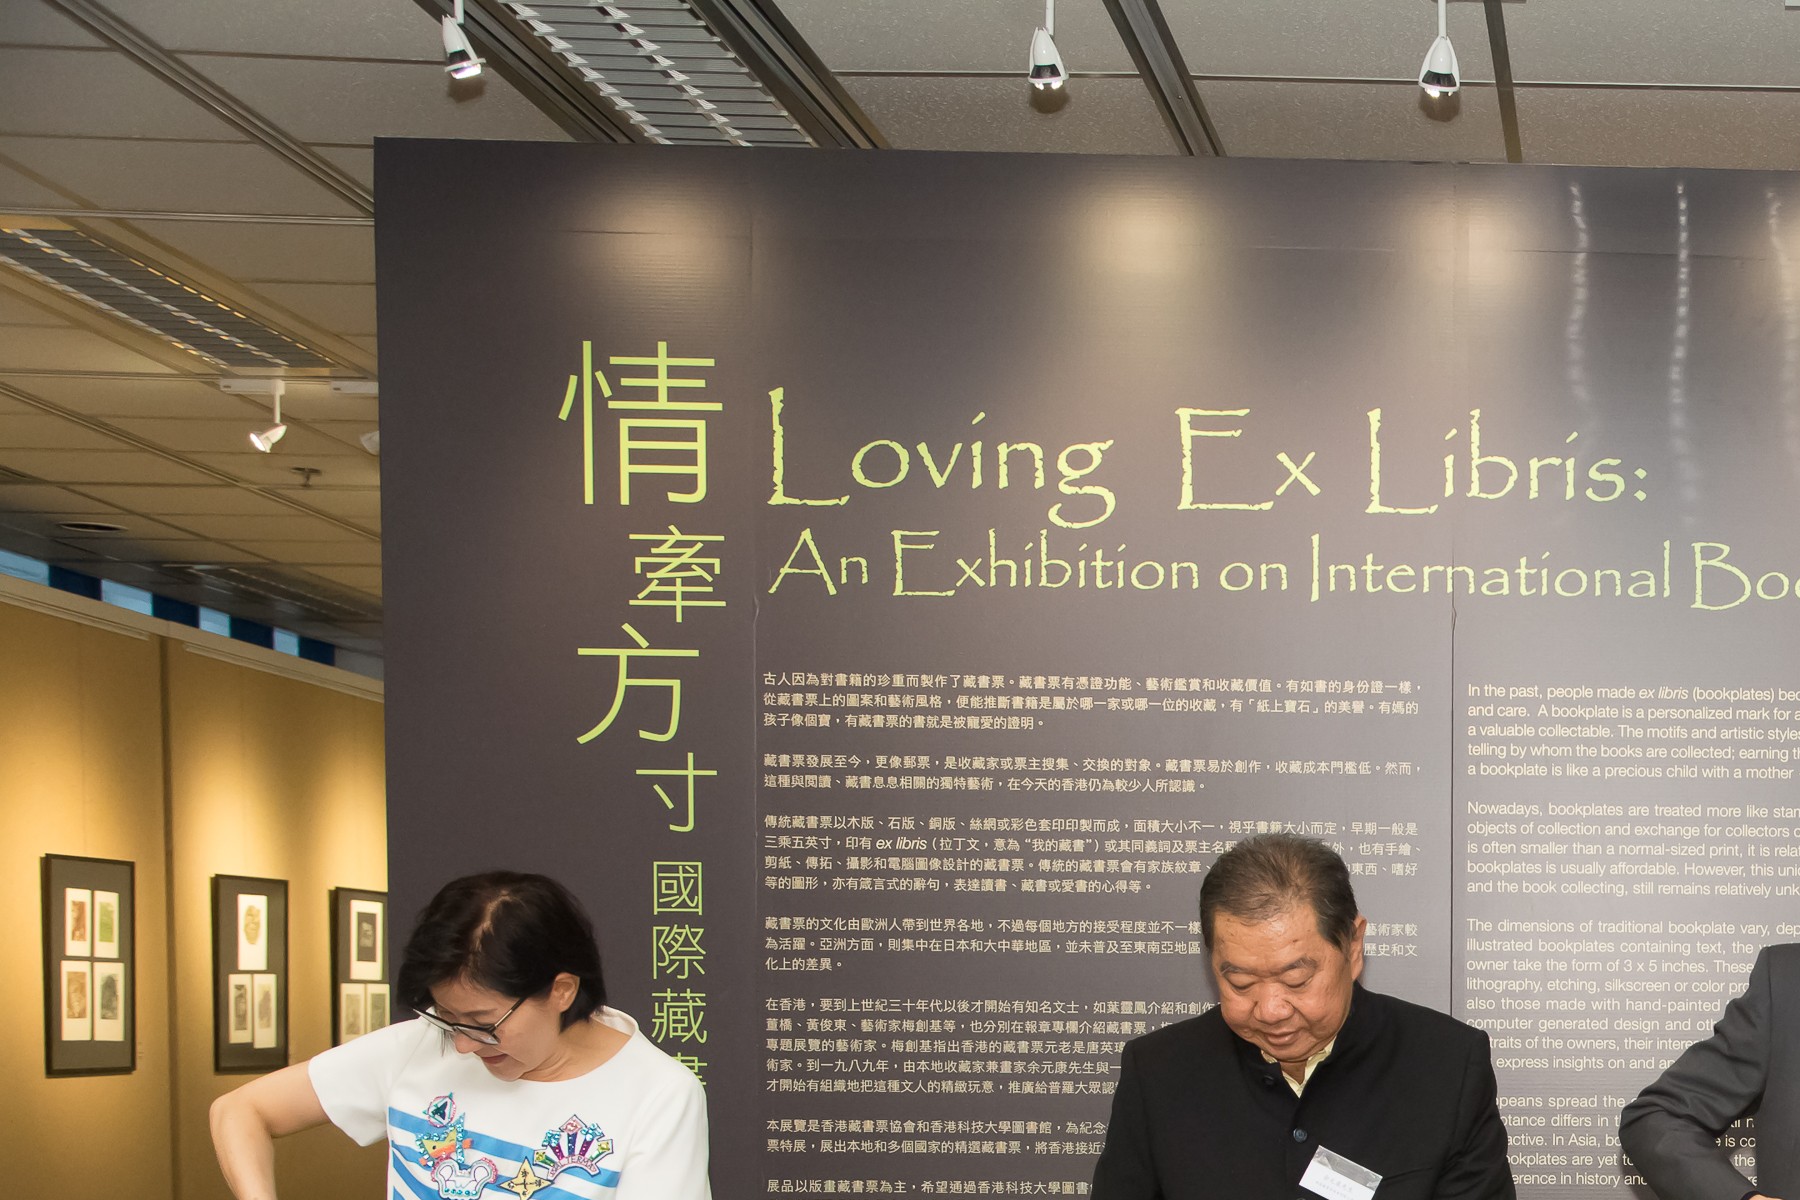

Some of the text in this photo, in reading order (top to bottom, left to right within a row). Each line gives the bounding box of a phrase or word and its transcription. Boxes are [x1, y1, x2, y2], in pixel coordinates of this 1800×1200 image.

[766, 387, 1650, 530] Loving Ex Libris:
[767, 528, 870, 597] An
[891, 527, 1200, 598] Exhibition
[1219, 561, 1289, 592] on
[1310, 533, 1671, 602] International
[558, 339, 727, 834] 情牽方寸
[1469, 684, 1480, 696] In
[1484, 684, 1505, 697] the
[1510, 686, 1542, 699] past,
[1548, 686, 1593, 700] people
[1597, 686, 1635, 698] made
[1639, 689, 1655, 698] ex
[1658, 687, 1688, 699] libris
[1693, 687, 1774, 703] (bookplates)
[1468, 726, 1476, 735] a
[1480, 724, 1534, 736] valuable
[1539, 724, 1613, 737] collectable.
[1618, 725, 1643, 737] The
[1647, 726, 1687, 738] motifs
[1691, 727, 1716, 738] and
[1721, 728, 1764, 739] artistic
[876, 839, 897, 849] ex
[892, 837, 927, 850] libris
[765, 957, 841, 971] 化上的差異。
